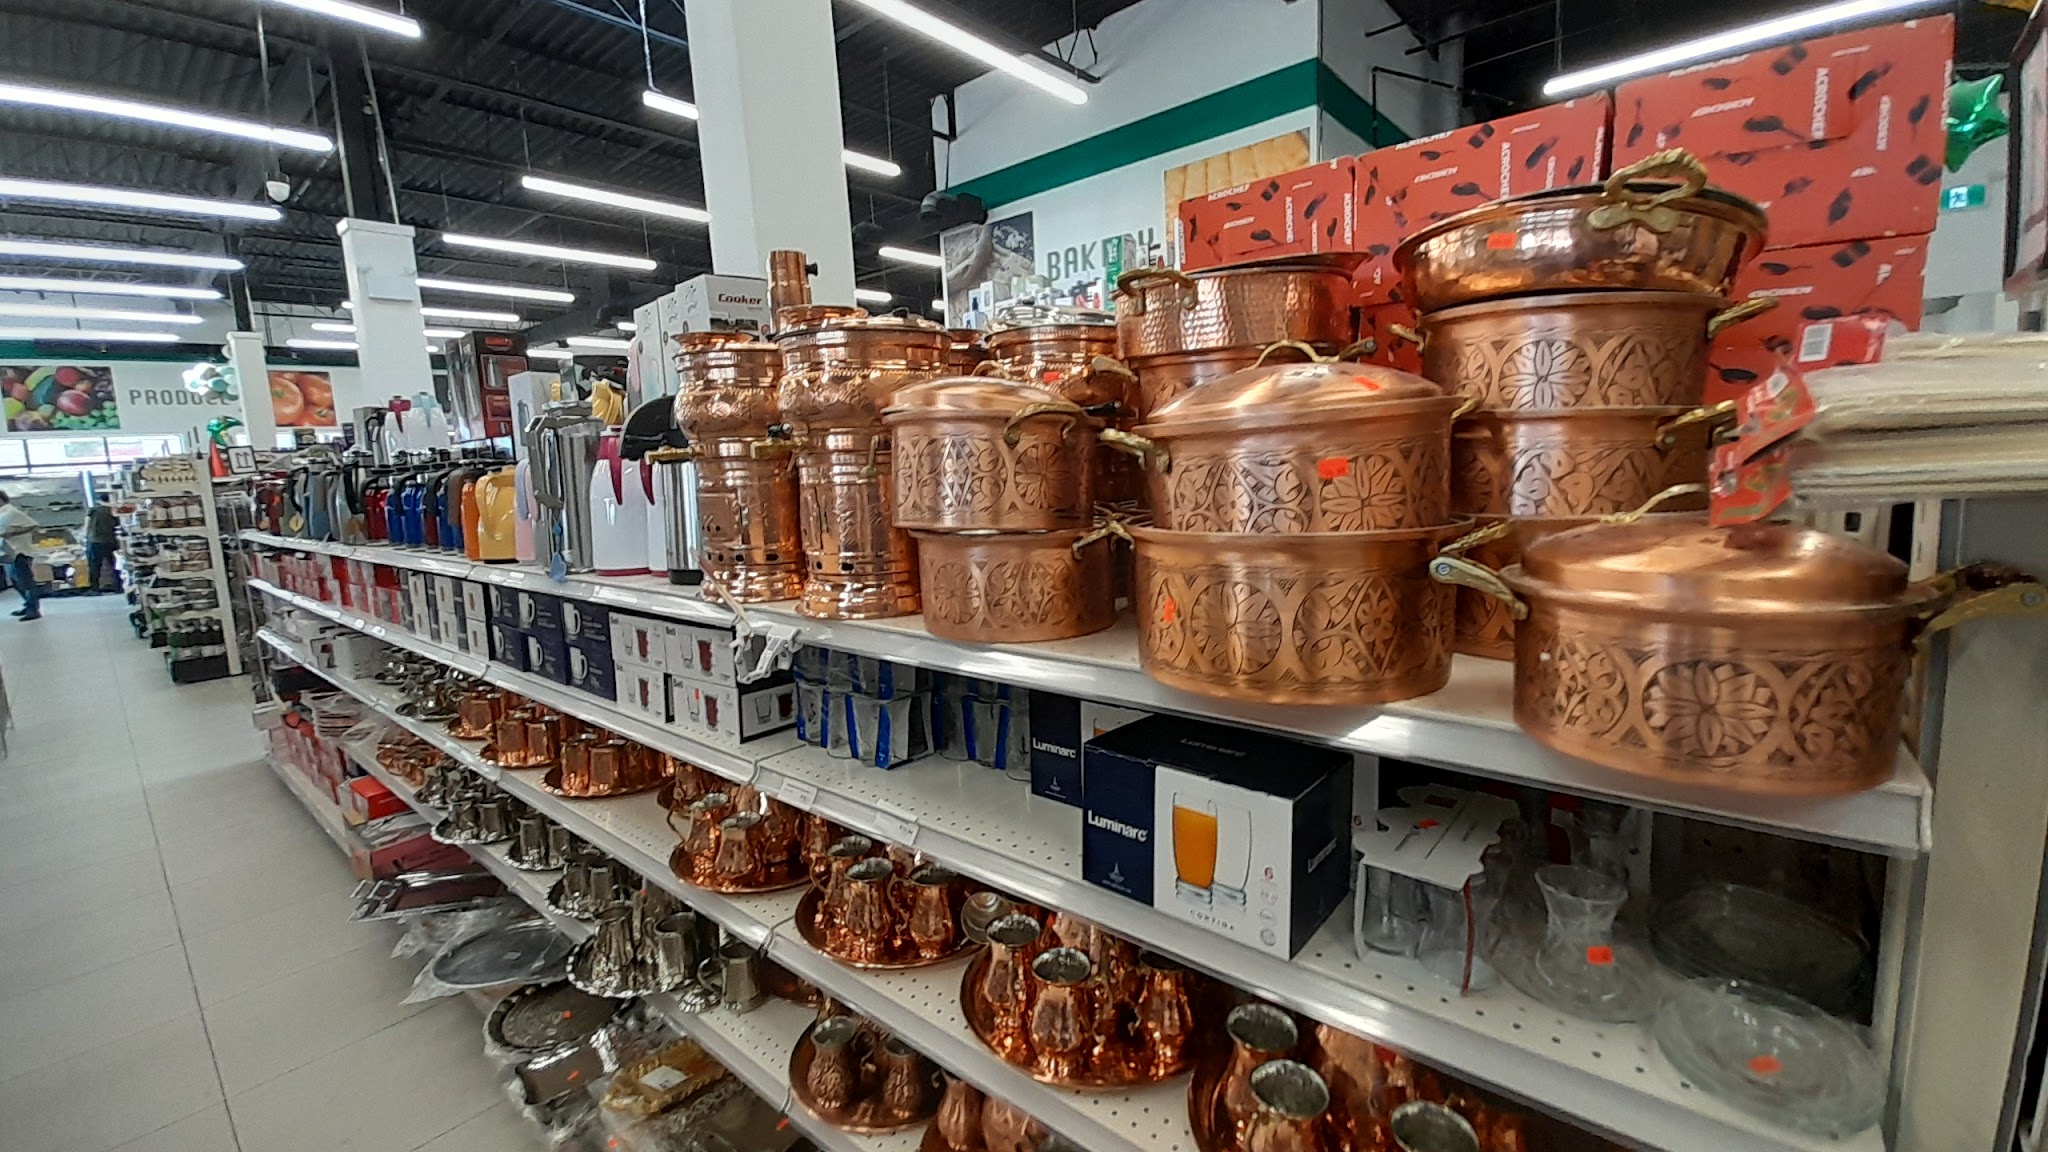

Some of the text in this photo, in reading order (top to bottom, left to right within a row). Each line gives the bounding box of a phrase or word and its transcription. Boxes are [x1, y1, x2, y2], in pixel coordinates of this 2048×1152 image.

[1047, 227, 1155, 282] BAKY
[718, 293, 763, 305] Cooker
[1032, 736, 1078, 759] Luminarc
[1087, 808, 1149, 843] Luminarc
